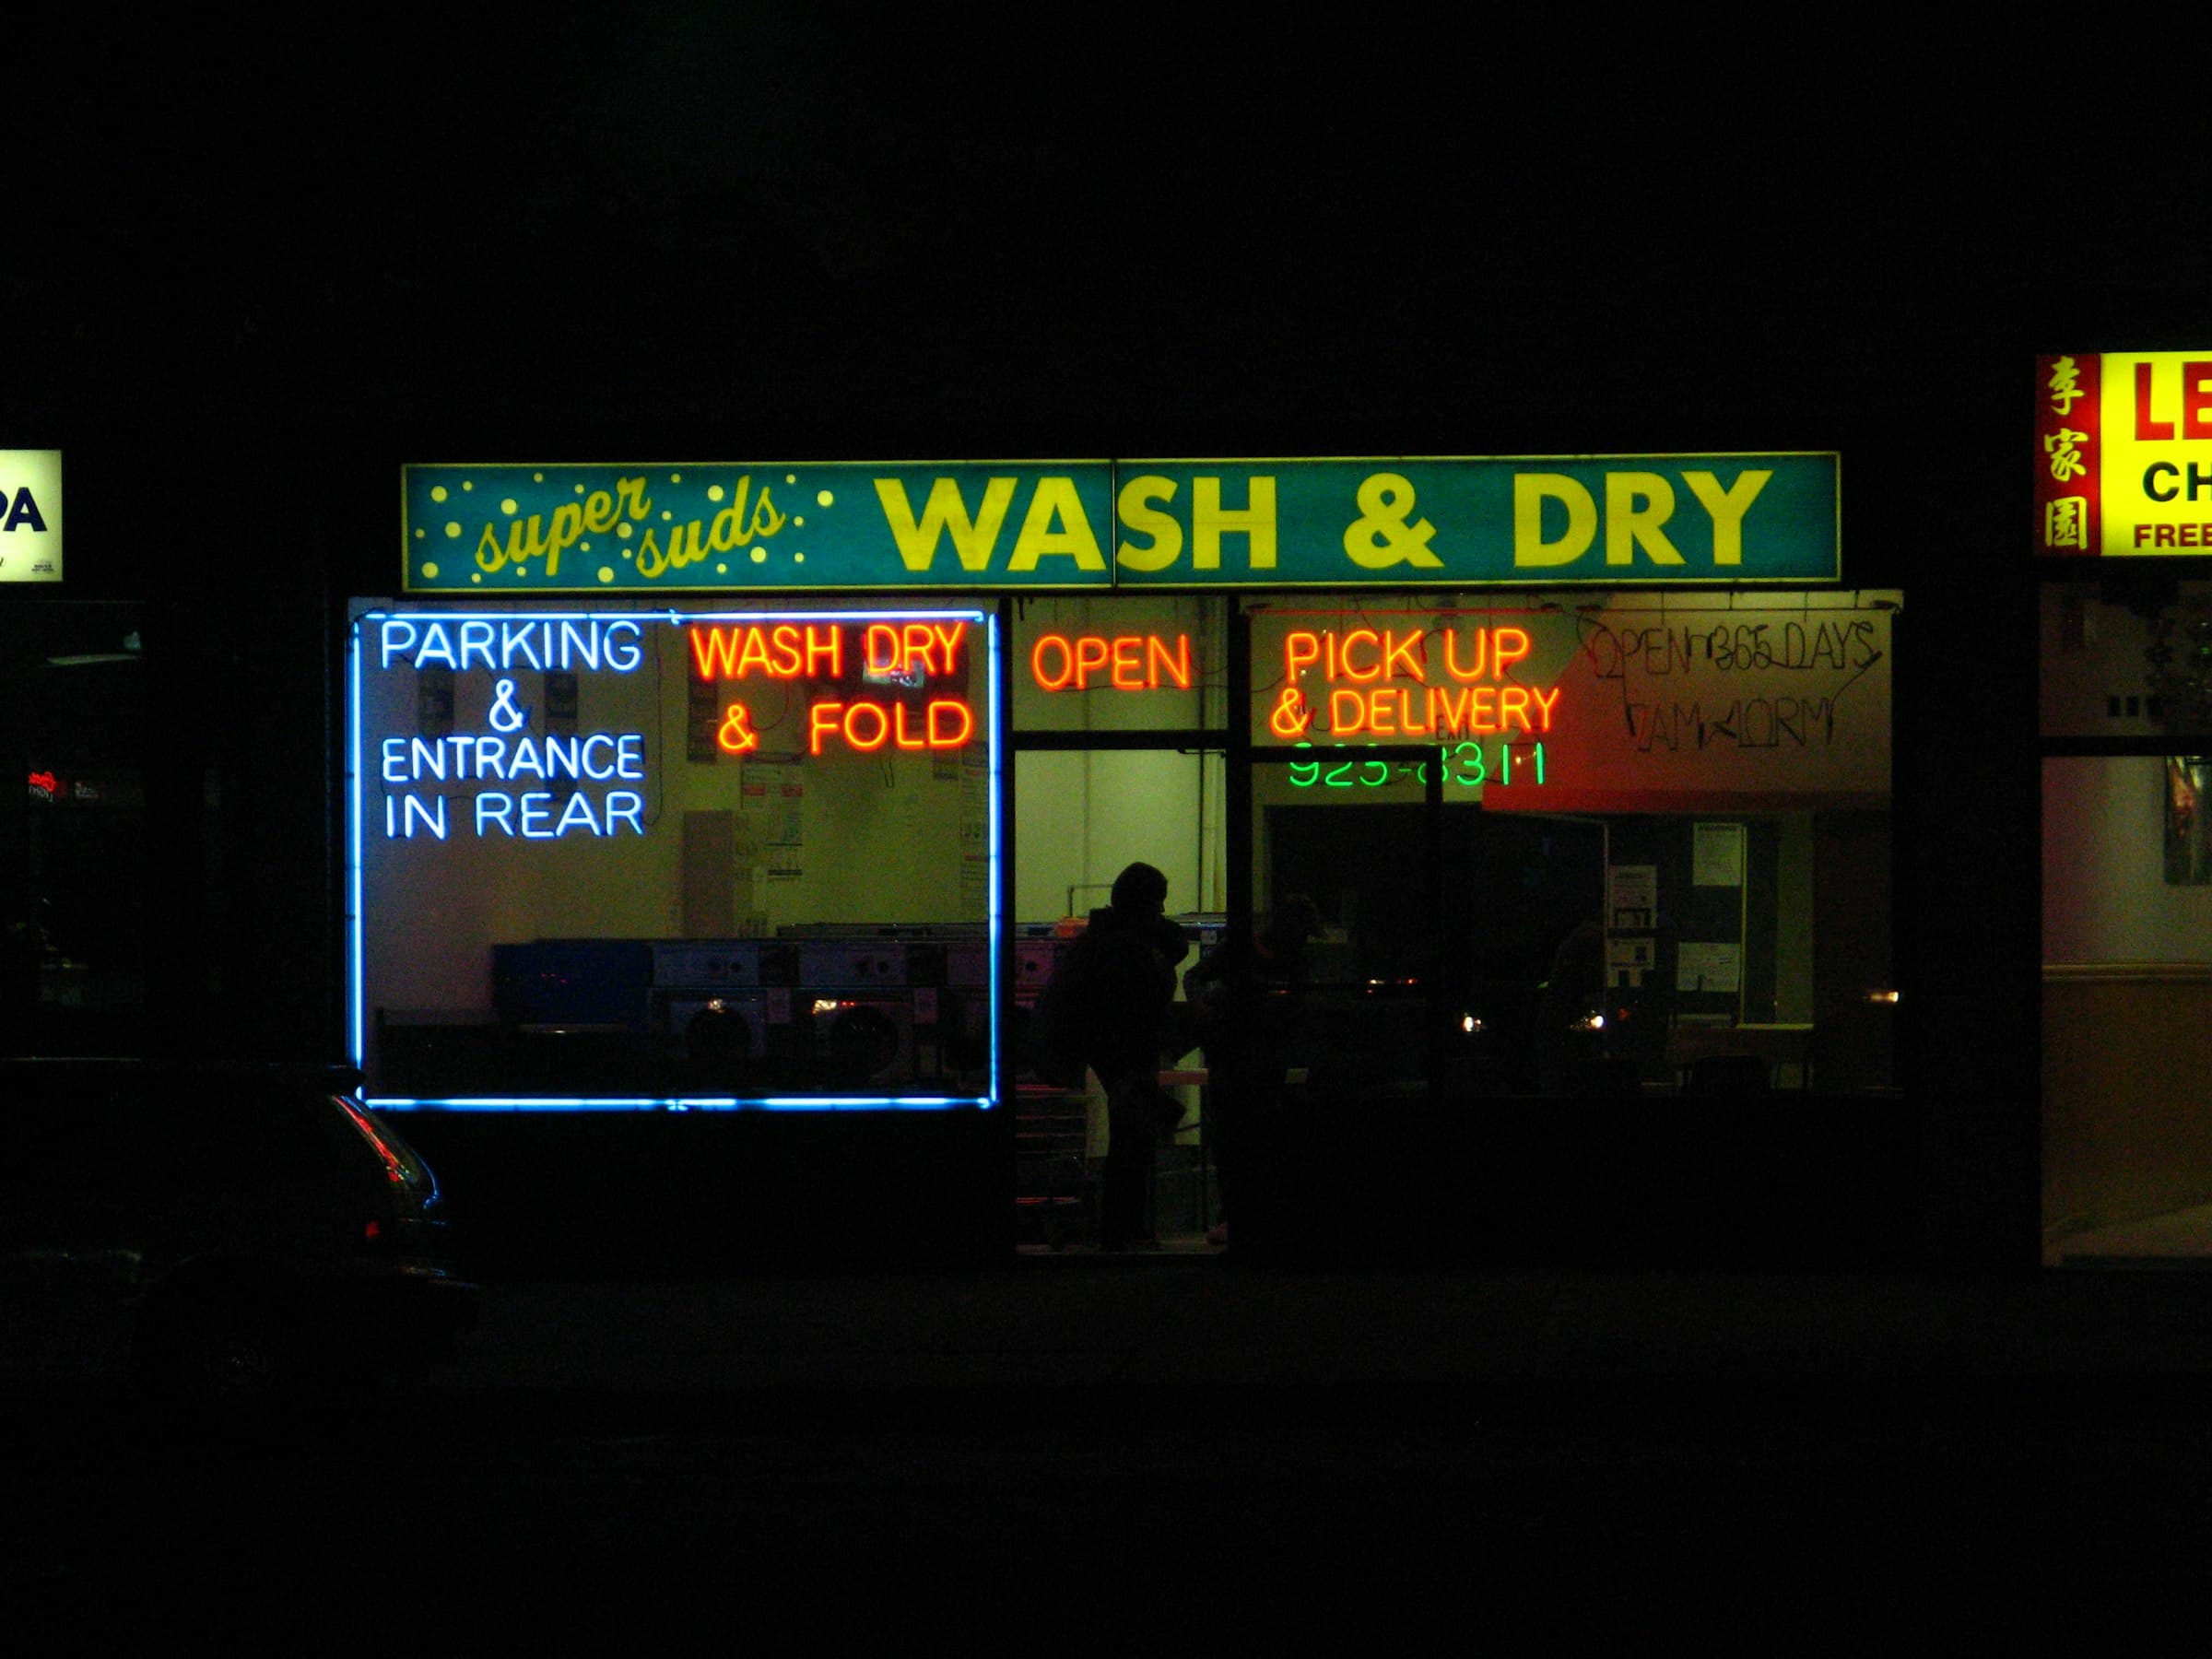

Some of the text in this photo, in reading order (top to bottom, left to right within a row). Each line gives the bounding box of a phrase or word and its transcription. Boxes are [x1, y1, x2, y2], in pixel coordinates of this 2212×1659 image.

[476, 476, 651, 576] super
[636, 475, 788, 578] suds
[873, 470, 1773, 571] WASH & DRY
[381, 619, 642, 672] PARKING
[691, 620, 965, 680] WASH DRY
[1030, 633, 1192, 691] OPEN
[1284, 627, 1531, 683] PICK UP
[1593, 624, 1690, 678] OPEN
[1784, 620, 1882, 669] DAYS
[488, 677, 524, 733] &
[717, 699, 974, 756] & FOLD
[1270, 686, 1560, 735] & DELIVERY
[382, 734, 643, 782] ENTRANCE
[385, 791, 643, 840] IN REAR
